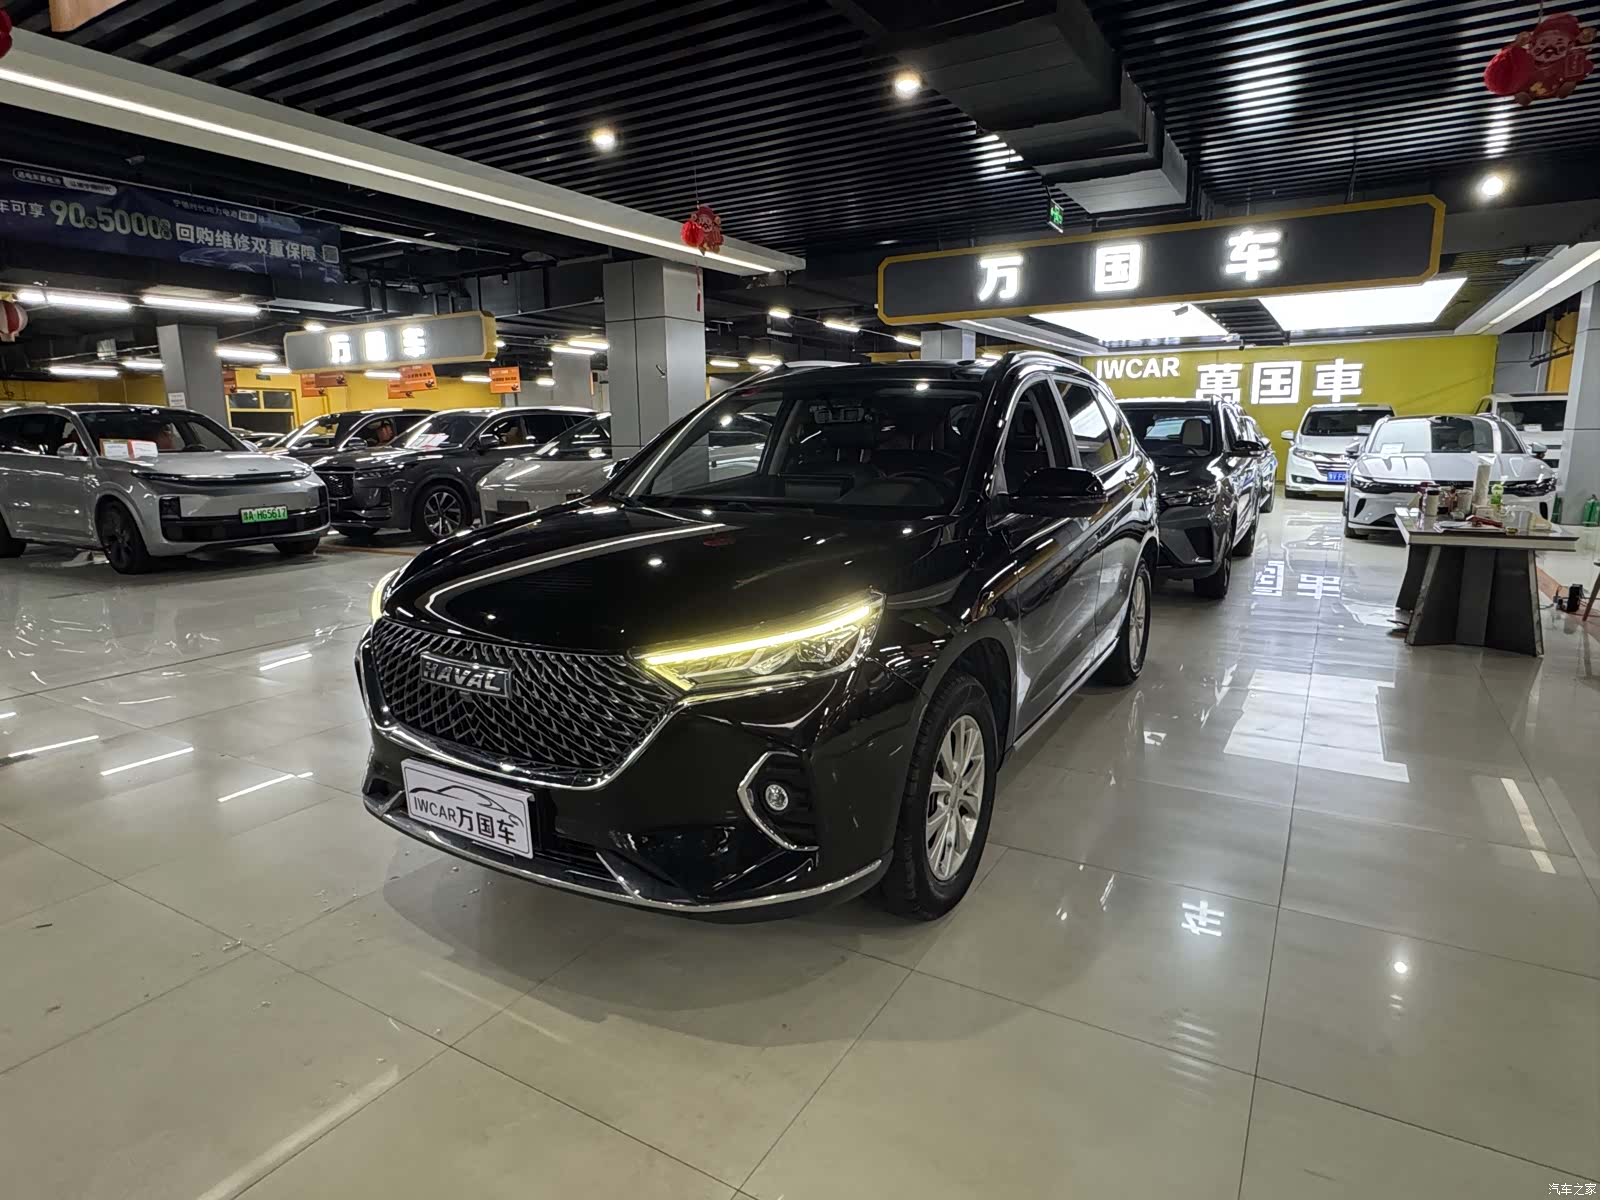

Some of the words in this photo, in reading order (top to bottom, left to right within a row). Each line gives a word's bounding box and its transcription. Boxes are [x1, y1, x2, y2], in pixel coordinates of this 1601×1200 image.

[175, 222, 318, 262] 回购维修双重保障
[978, 230, 1282, 301] 万国车
[1096, 356, 1181, 380] IWCAR
[423, 661, 502, 692] HAVAL
